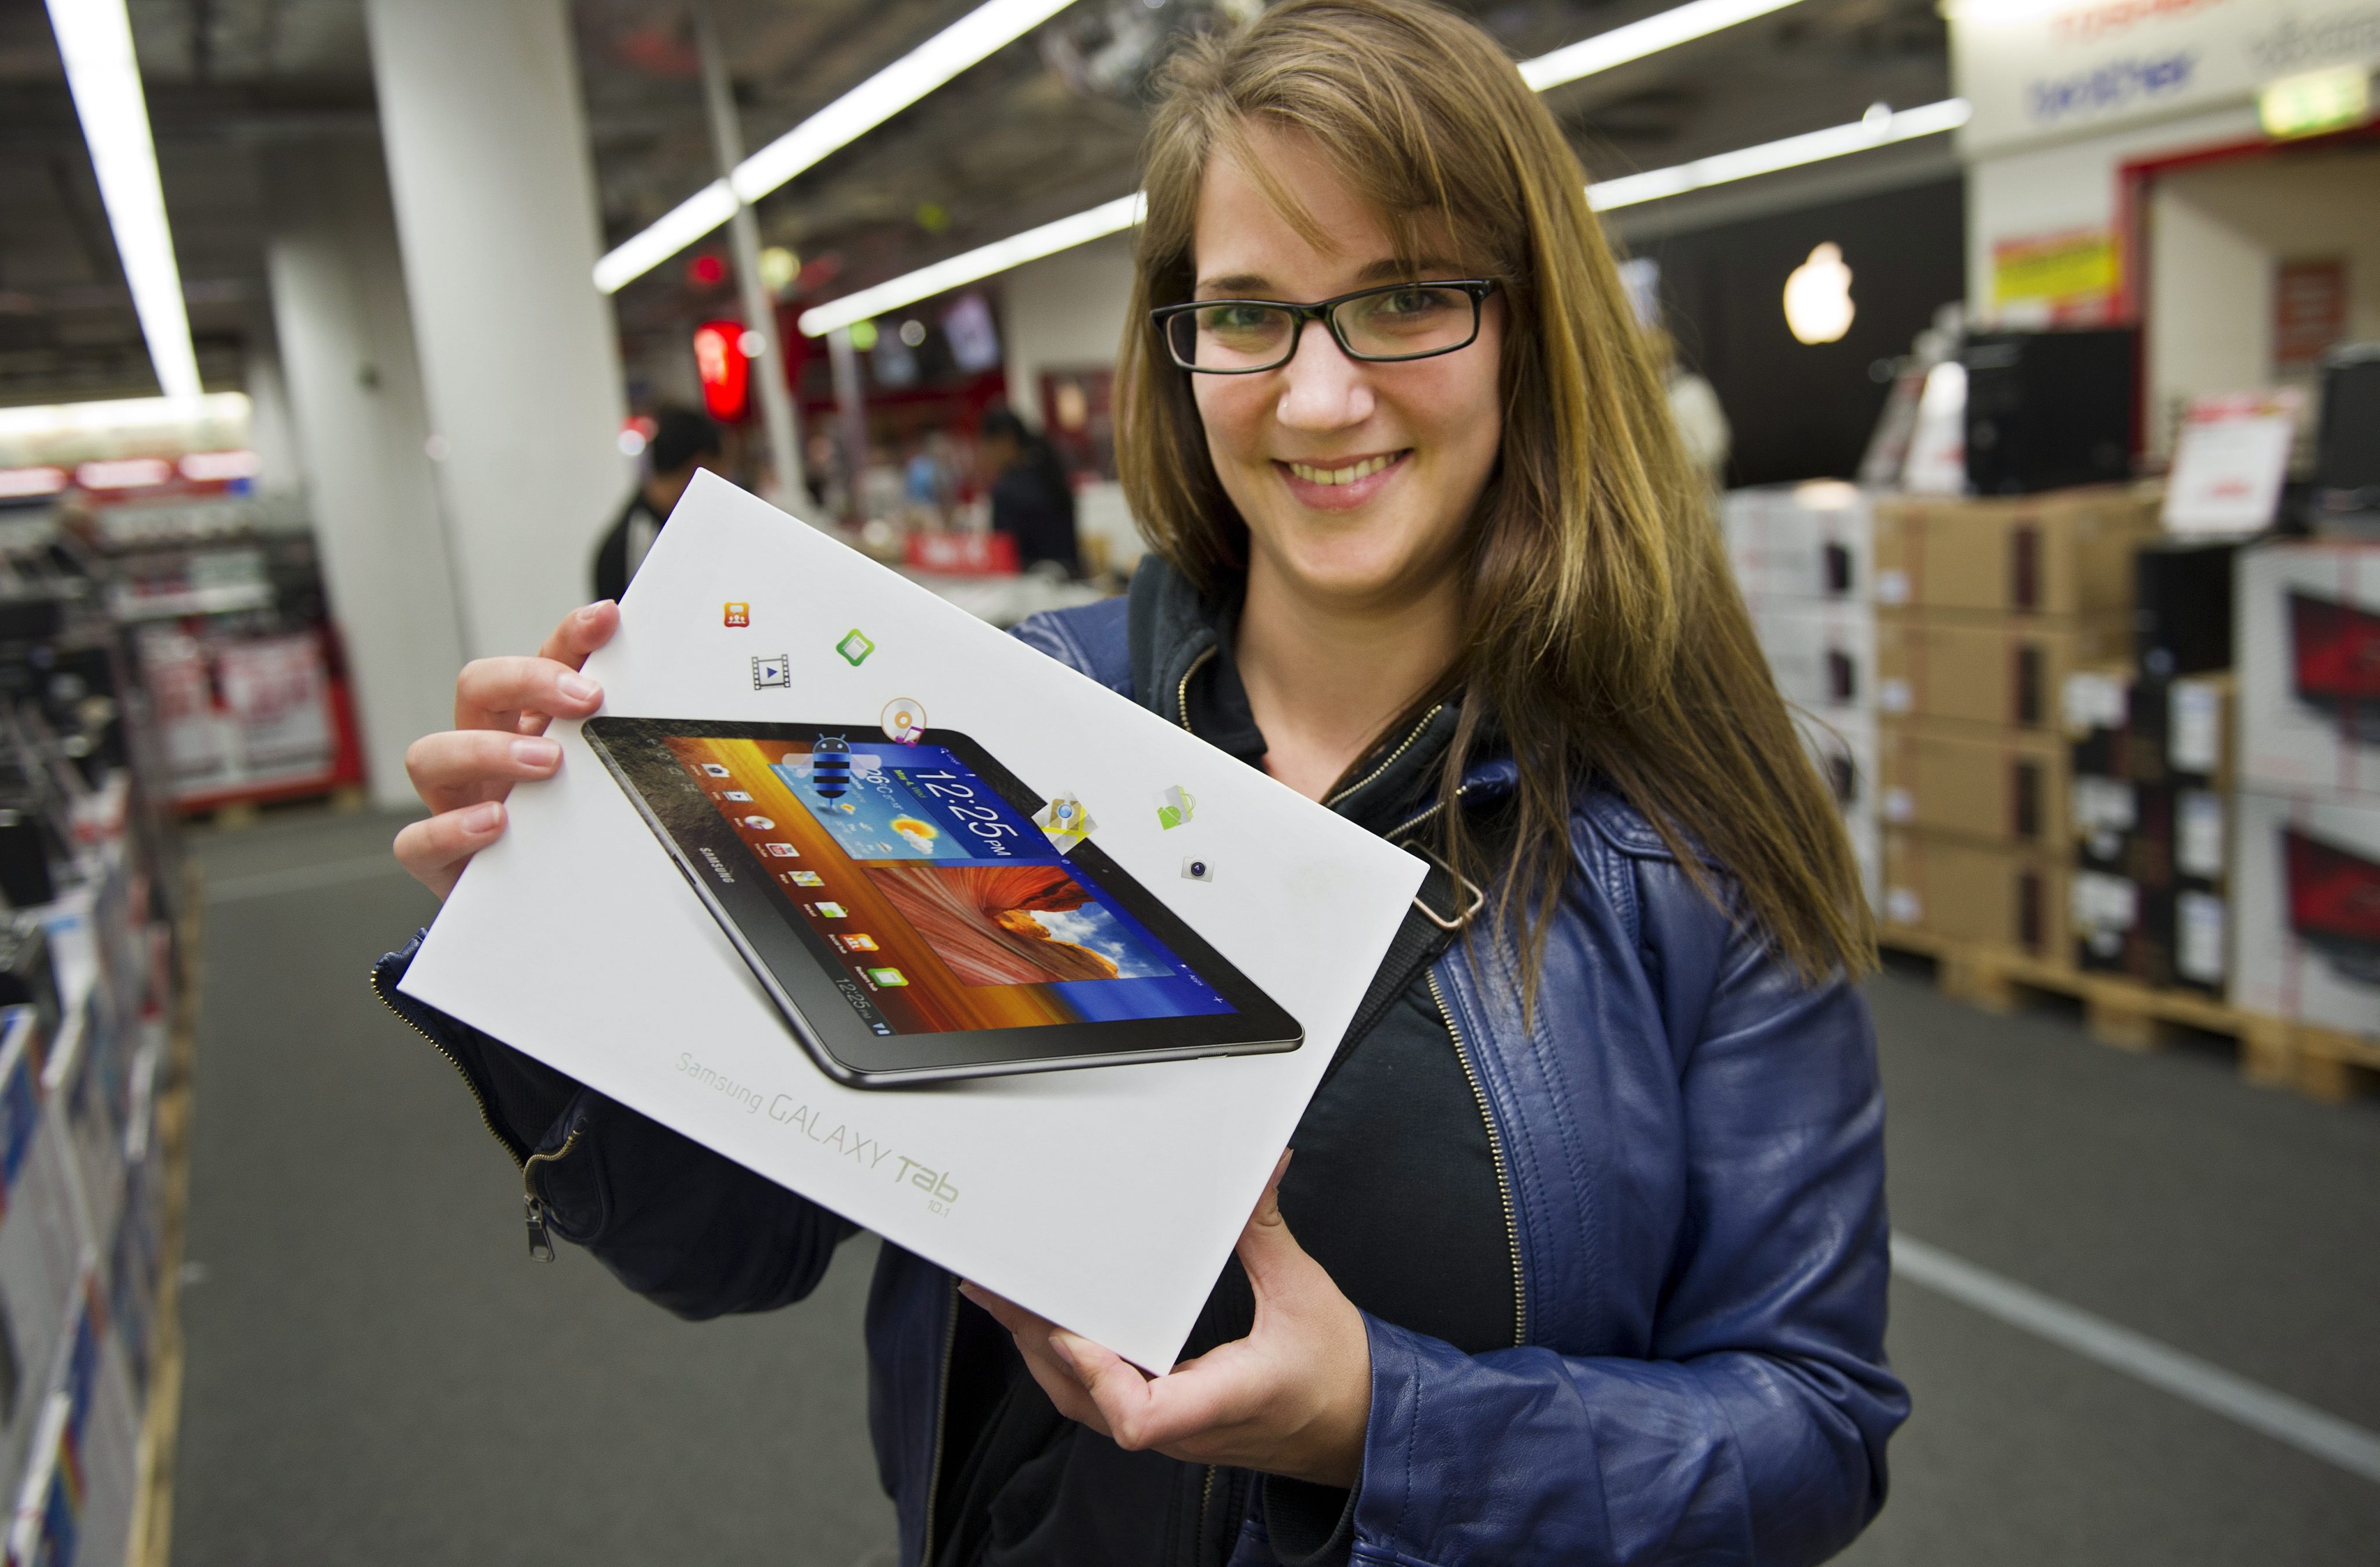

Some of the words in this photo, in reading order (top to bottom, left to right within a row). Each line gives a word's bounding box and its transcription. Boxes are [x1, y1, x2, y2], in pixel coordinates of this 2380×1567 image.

[916, 770, 1018, 837] 12:25
[984, 840, 1011, 855] PM
[699, 848, 734, 883] SAMSUNG
[836, 978, 870, 1009] 12:25
[676, 1052, 763, 1114] Samsung
[769, 1094, 891, 1168] GALAXY
[895, 1155, 959, 1203] Tab
[928, 1200, 951, 1218] 10.1
